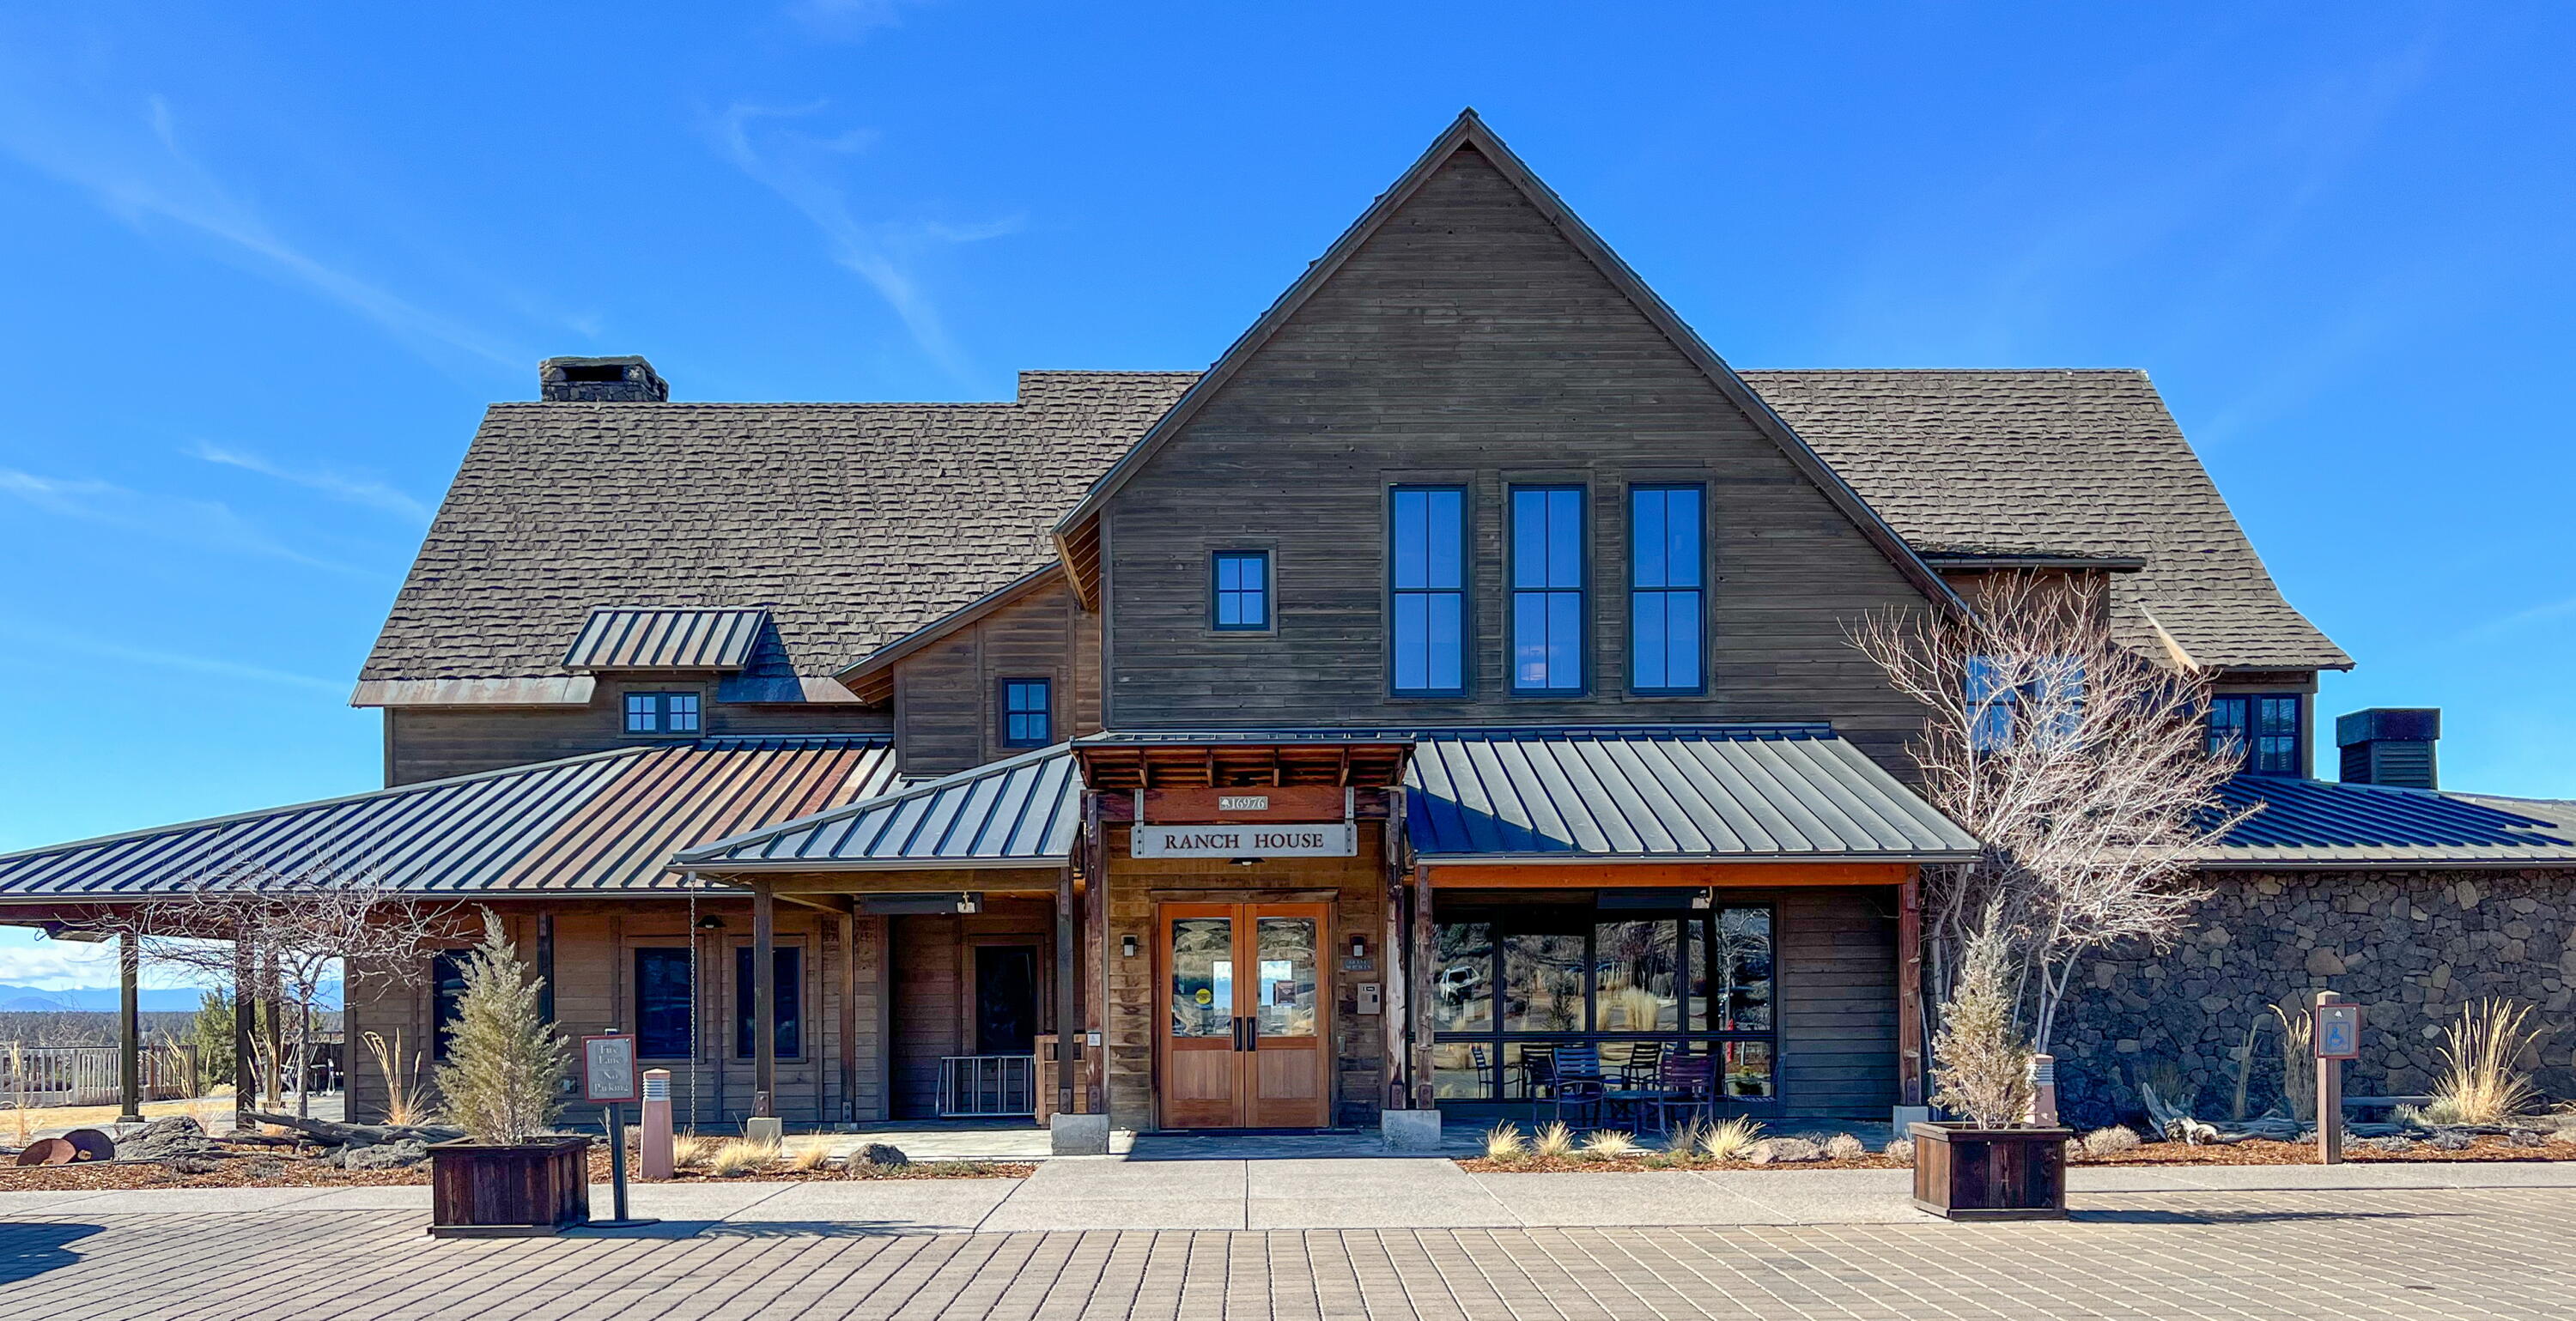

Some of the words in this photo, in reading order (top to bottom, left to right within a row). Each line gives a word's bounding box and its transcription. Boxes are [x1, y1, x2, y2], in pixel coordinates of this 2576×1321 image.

[1231, 797, 1265, 809] 16976
[1164, 834, 1240, 850] RANCH
[1254, 833, 1324, 849] HOUSE
[598, 1055, 621, 1065] Lane
[603, 1070, 619, 1080] No
[593, 1082, 629, 1094] Parking
